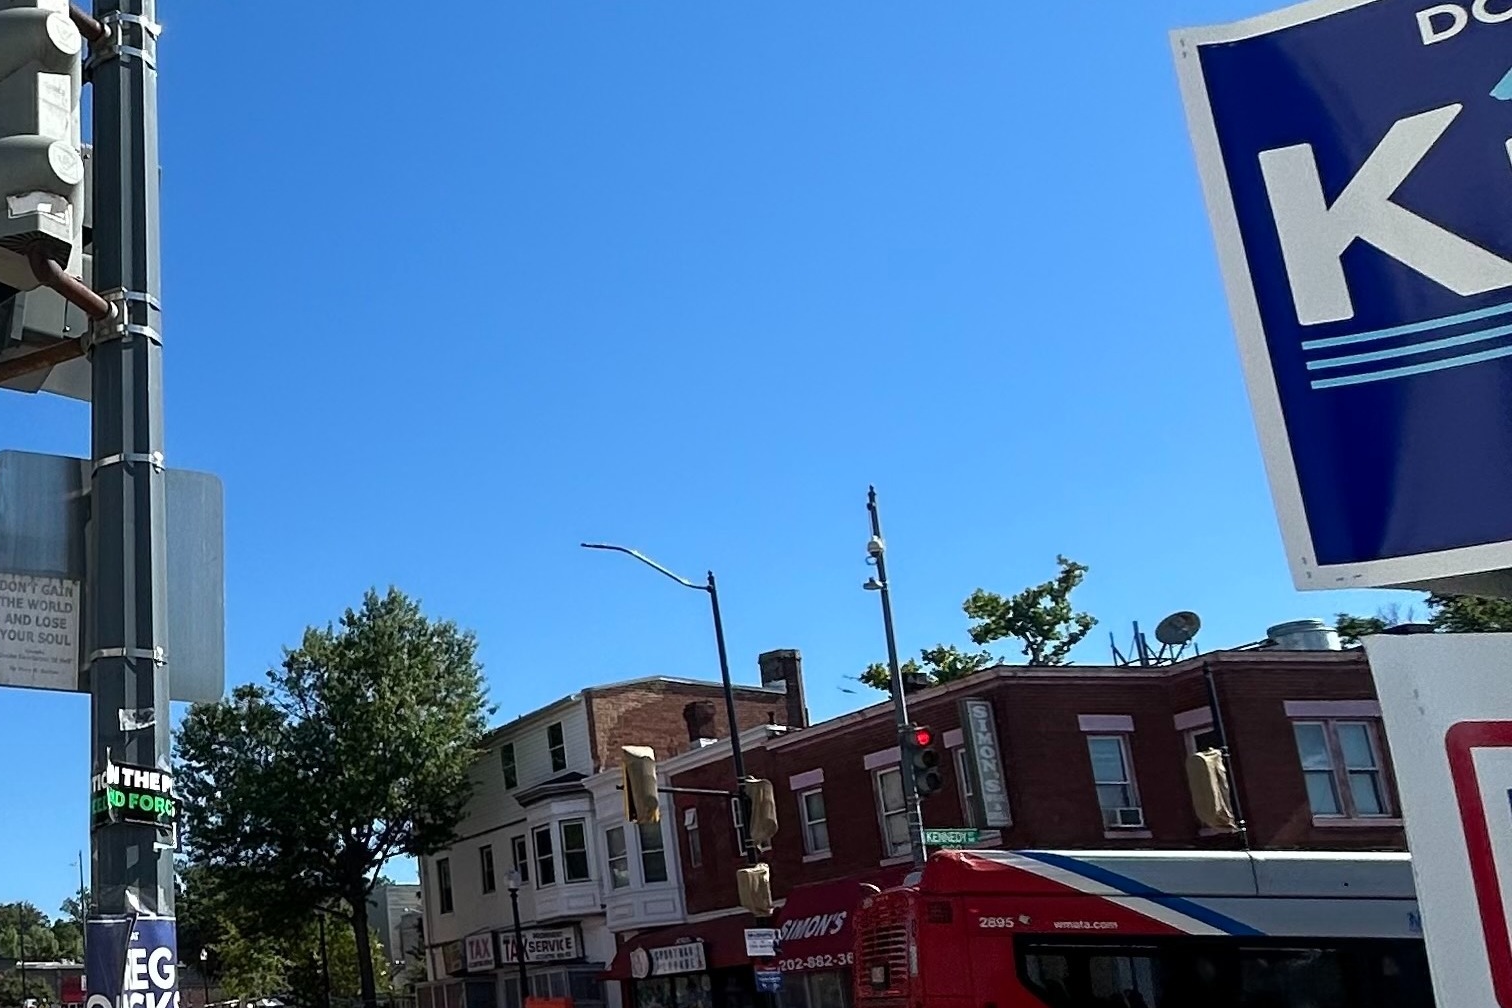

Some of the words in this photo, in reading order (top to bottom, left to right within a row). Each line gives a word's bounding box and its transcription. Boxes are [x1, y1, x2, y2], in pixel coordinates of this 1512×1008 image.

[1257, 102, 1512, 326] K
[0, 579, 38, 596] DON'T
[41, 581, 73, 597] GAIN
[0, 596, 24, 608] THE
[27, 598, 73, 613] WORLD
[5, 613, 31, 625] AND
[35, 615, 67, 629] LOSE
[0, 629, 34, 643] YOUR
[38, 632, 71, 646] SOUL
[926, 831, 966, 843] KENNEDY
[781, 911, 847, 941] SIMON'S
[1053, 920, 1118, 929] wmata.com
[469, 938, 491, 959] TAX
[502, 937, 530, 961] TAX
[528, 937, 573, 953] SERVICE
